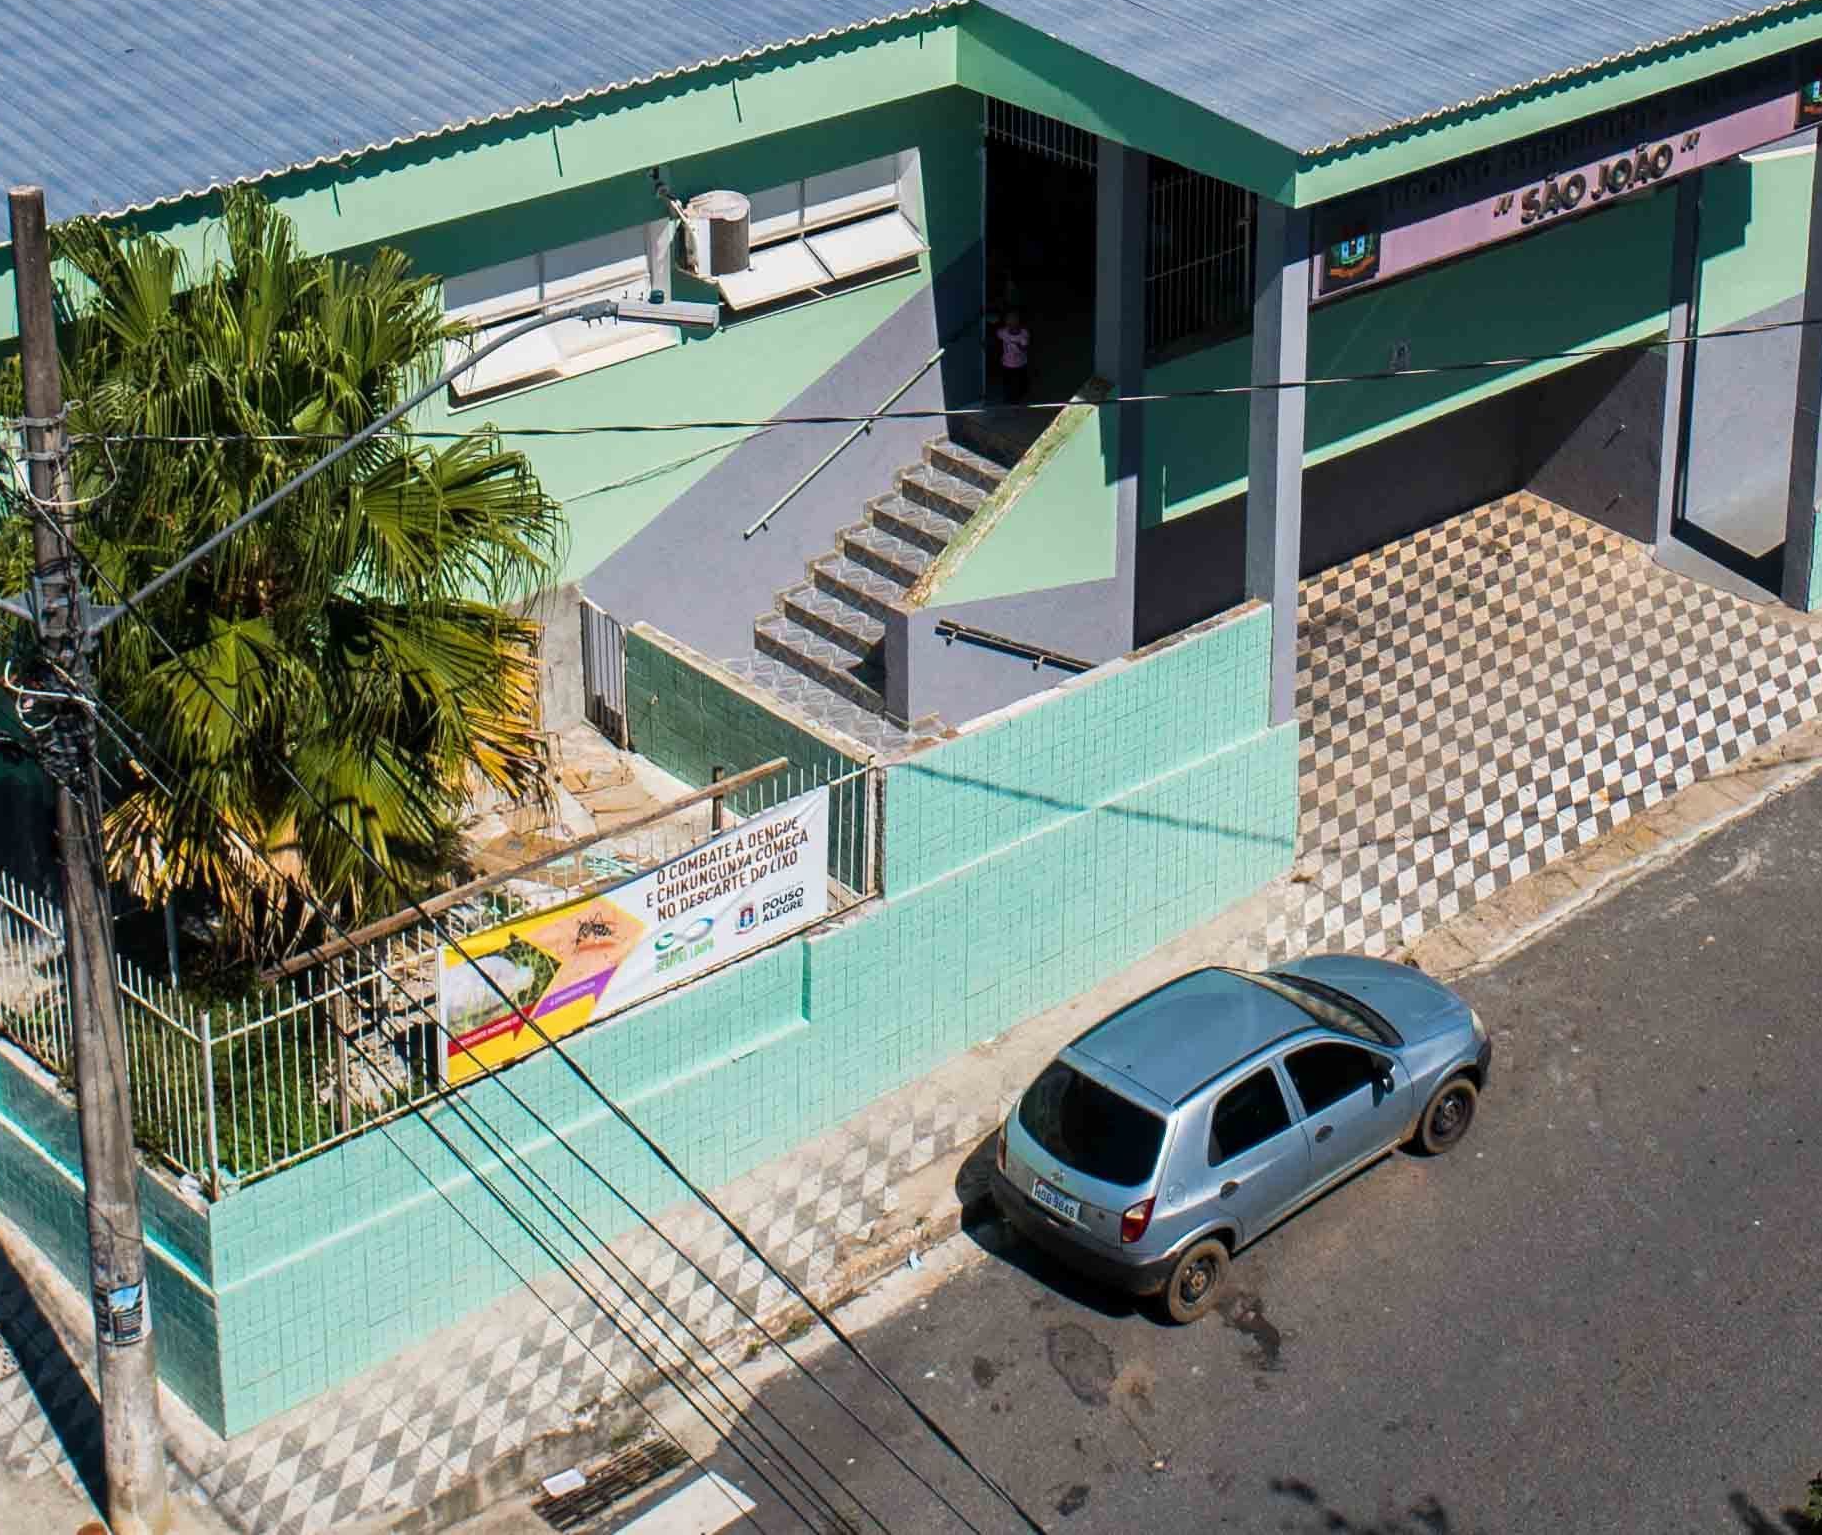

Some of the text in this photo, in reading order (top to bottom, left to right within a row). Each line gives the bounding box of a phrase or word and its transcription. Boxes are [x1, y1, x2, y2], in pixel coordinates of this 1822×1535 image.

[646, 893, 654, 908] E
[657, 855, 752, 904] CHIKUNGUNYA
[755, 829, 808, 862] COMEÇA
[657, 870, 666, 884] O
[669, 842, 731, 880] COMBATE
[748, 817, 798, 849] DENGUE
[657, 902, 676, 922] NO
[680, 872, 747, 914] DESCARTE
[750, 864, 767, 884] DO
[770, 850, 798, 873] LIXO
[762, 887, 804, 913] POUSO
[762, 898, 804, 924] ALEGRE
